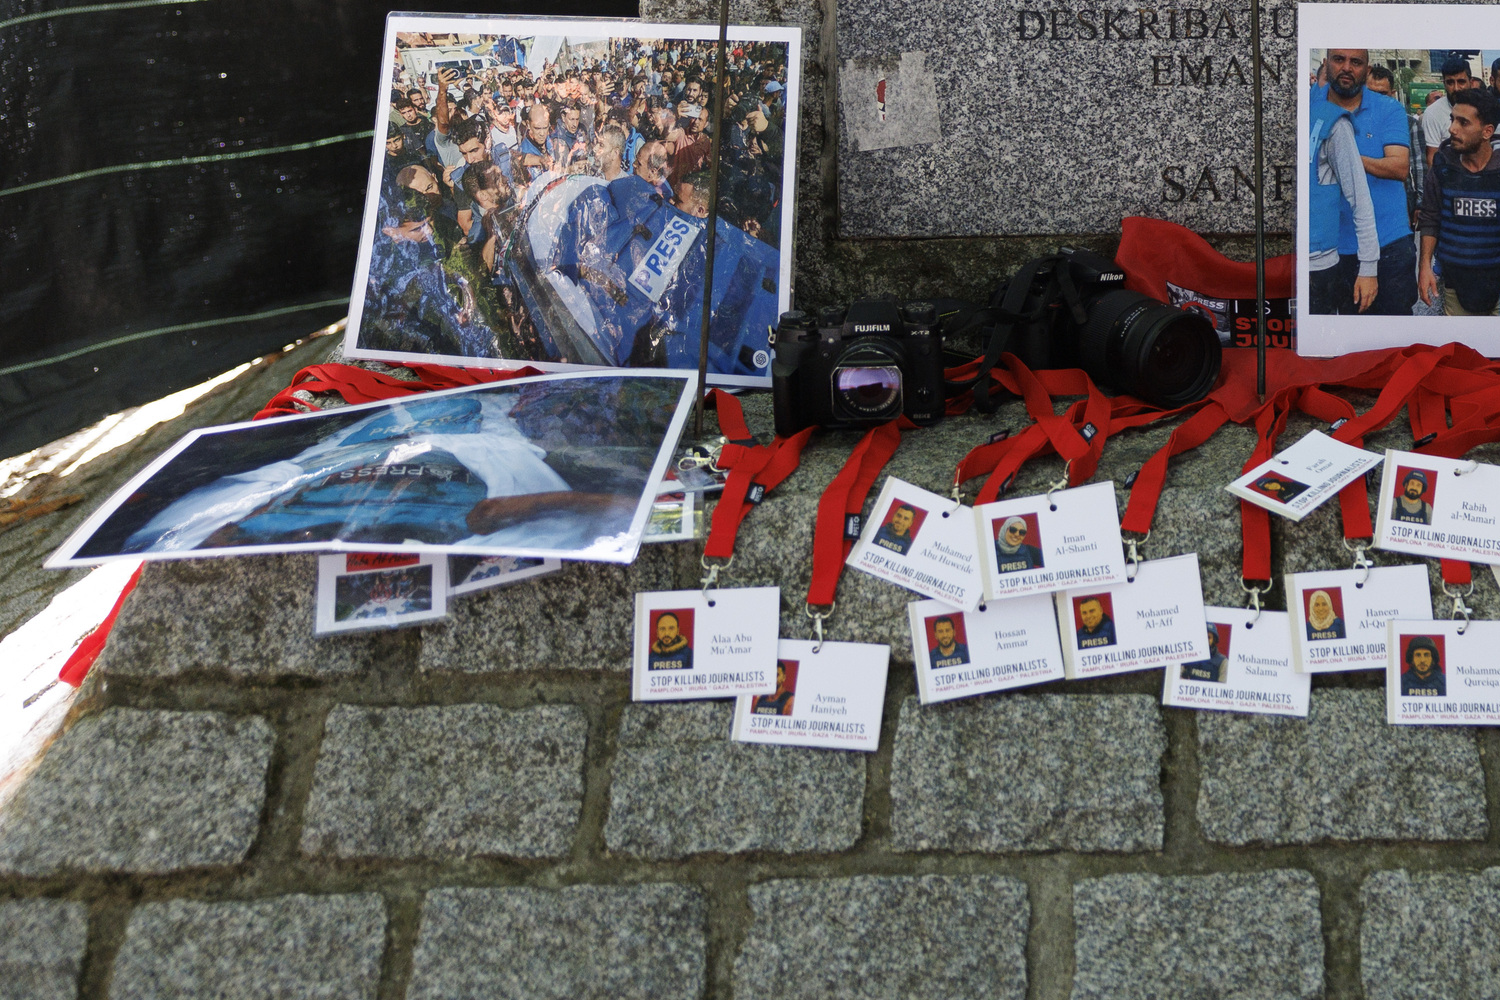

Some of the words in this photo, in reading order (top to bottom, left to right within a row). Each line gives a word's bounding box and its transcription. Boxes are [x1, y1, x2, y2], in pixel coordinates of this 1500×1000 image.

[1152, 55, 1282, 86] EMAN
[1454, 199, 1497, 217] PRESS
[634, 215, 690, 293] PRESS
[1101, 273, 1123, 281] Nikon
[1193, 296, 1225, 310] PRESS
[1462, 501, 1487, 512] Rabih
[1451, 512, 1495, 525] al-Mamari
[1063, 534, 1085, 543] Iman
[1391, 526, 1413, 537] STOP
[1414, 529, 1445, 542] KILLING
[1446, 533, 1500, 550] JOURNALISTS
[1055, 542, 1098, 555] Al-Shanti
[921, 548, 941, 562] Abu
[1137, 606, 1179, 618] Mohamed
[712, 635, 731, 643] Alaa
[735, 634, 752, 642] Abu
[996, 639, 1028, 650] Ammar
[654, 661, 682, 669] PRESS
[1238, 654, 1288, 666] Mohammed
[1245, 666, 1278, 677] Salama
[651, 676, 671, 686] STOP
[675, 673, 706, 685] KILLING
[708, 671, 764, 683] JOURNALISTS
[815, 694, 846, 704] Ayman
